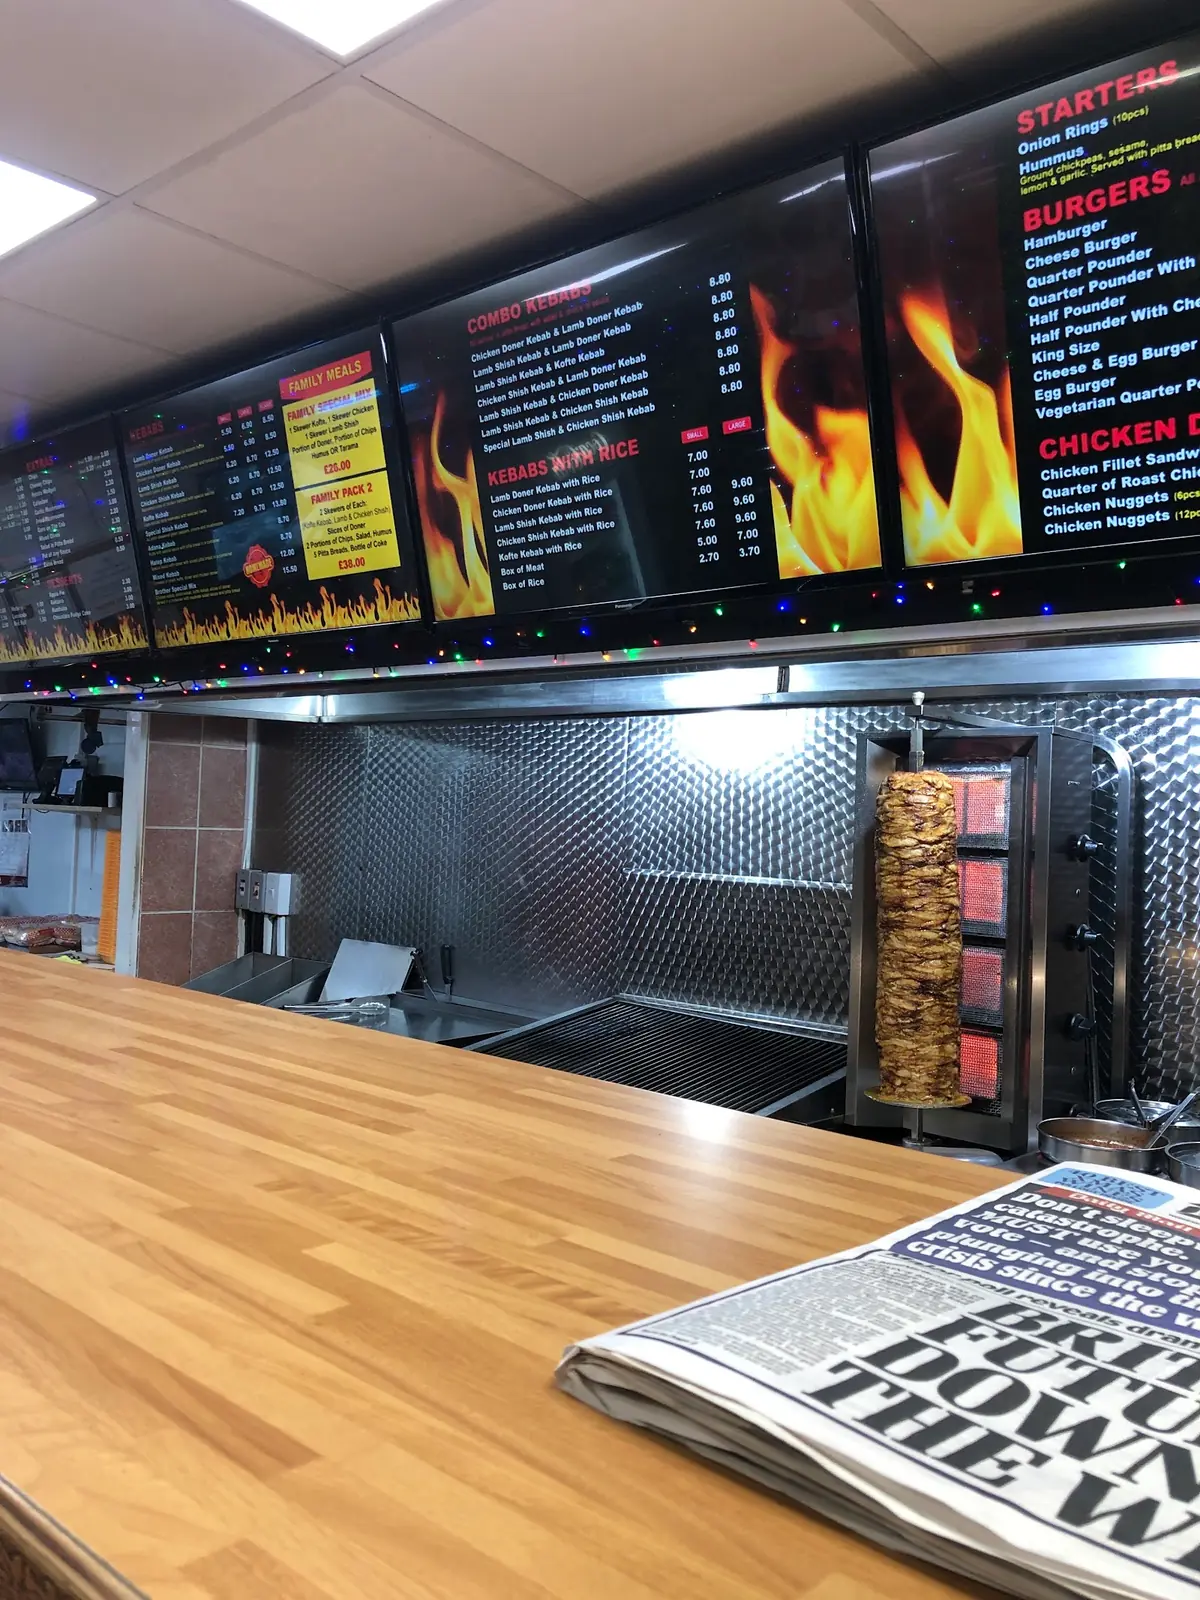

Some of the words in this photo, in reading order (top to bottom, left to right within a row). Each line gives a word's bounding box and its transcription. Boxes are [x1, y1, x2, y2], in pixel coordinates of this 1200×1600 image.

[1016, 60, 1179, 134] STARTERS
[1018, 134, 1060, 155] Onion
[1065, 118, 1108, 140] Rings
[1113, 105, 1149, 126] (10pcs)
[1019, 146, 1085, 175] Hummus
[1020, 168, 1055, 185] Ground
[1056, 152, 1106, 174] chickpeas,
[1108, 140, 1148, 158] sesame,
[1020, 181, 1048, 195] lemon
[1050, 177, 1057, 186] &
[1091, 157, 1124, 174] Served
[1126, 150, 1148, 162] with
[1150, 142, 1172, 157] pitta
[1023, 168, 1172, 232] BURGERS
[1024, 219, 1107, 251] Hamburger
[1026, 247, 1080, 269] Cheese
[1084, 231, 1137, 254] Burger
[710, 272, 731, 287] 8.80
[1027, 266, 1084, 288] Quarter
[1088, 248, 1152, 273] Pounder
[1028, 286, 1085, 307] Quarter
[1089, 268, 1154, 293] Pounder
[1157, 256, 1195, 275] With
[468, 304, 521, 334] COMBO
[526, 282, 592, 314] KEBABS
[1029, 309, 1059, 327] Half
[1064, 295, 1126, 319] Pounder
[1031, 328, 1060, 345] Half
[1065, 315, 1127, 338] Pounder
[1131, 304, 1168, 322] With
[471, 348, 500, 362] Chicken
[502, 340, 524, 353] Doner
[526, 331, 551, 345] Kebab
[553, 328, 560, 336] &
[562, 320, 584, 334] Lamb
[586, 312, 612, 326] Doner
[614, 301, 643, 317] Kebab
[1032, 349, 1064, 364] King
[1069, 342, 1100, 356] Size
[1033, 364, 1087, 382] Cheese
[1092, 358, 1103, 370] &
[1108, 353, 1137, 368] Egg
[1142, 340, 1198, 360] Burger
[289, 373, 323, 393] FAMILY
[326, 360, 361, 381] MEALS
[721, 380, 742, 394] 8.80
[1035, 388, 1061, 402] Egg
[1066, 377, 1116, 395] Burger
[1035, 397, 1116, 419] Vegetarian
[1120, 384, 1182, 403] Quarter
[484, 439, 510, 453] Special
[512, 434, 533, 446] Lamb
[534, 428, 556, 440] Shish
[558, 425, 564, 434] &
[566, 418, 599, 432] Chicken
[601, 410, 625, 423] Shish
[627, 403, 655, 417] Kebab
[687, 432, 703, 440] SMALL
[728, 420, 746, 430] LARGE
[1039, 418, 1176, 460] CHICKEN
[488, 460, 548, 486] KEBABS
[552, 450, 594, 472] WITH
[599, 439, 639, 462] RICE
[1041, 465, 1098, 481] Chicken
[1103, 456, 1141, 472] Fillet
[1146, 448, 1200, 465] Sandw
[311, 489, 340, 505] FAMILY
[342, 484, 365, 498] PACK
[367, 482, 372, 492] 2
[490, 493, 510, 503] Lamb
[512, 489, 534, 499] Doner
[536, 482, 560, 494] Kebab
[562, 478, 580, 488] with
[582, 475, 600, 485] Rice
[1042, 484, 1097, 499] Quarter
[1102, 478, 1116, 491] of
[1121, 472, 1166, 488] Roast
[1043, 502, 1100, 517] Chicken
[1105, 492, 1169, 509] Nuggets
[737, 528, 758, 540] 7.00
[1045, 520, 1102, 535] Chicken
[1106, 510, 1170, 528] Nuggets
[498, 552, 518, 561] Kofte
[520, 547, 544, 558] Kebab
[545, 544, 562, 554] with
[564, 542, 582, 551] Rice
[697, 535, 718, 546] 5.00
[699, 552, 719, 563] 2.70
[739, 546, 760, 557] 3.70
[338, 557, 365, 570] £38.00
[501, 568, 515, 576] Box
[516, 565, 524, 574] of
[526, 563, 544, 572] Meat
[518, 580, 526, 588] of
[528, 578, 544, 587] Rice
[971, 1210, 1081, 1241] MUST
[1077, 1238, 1142, 1259] use
[994, 1202, 1189, 1260] catastrophe.
[1010, 1192, 1102, 1219] Don't
[1100, 1216, 1200, 1251] sleep
[953, 1218, 1025, 1242] vote
[1054, 1246, 1130, 1270] and
[906, 1241, 999, 1271] crisis
[995, 1265, 1097, 1298] since
[1098, 1291, 1168, 1318] the
[923, 1230, 1086, 1276] plunging
[1082, 1269, 1165, 1298] into
[1016, 1293, 1124, 1327] reveals
[914, 1315, 1200, 1446] FUTU
[802, 1359, 1054, 1488] THE
[1054, 1470, 1200, 1572] W
